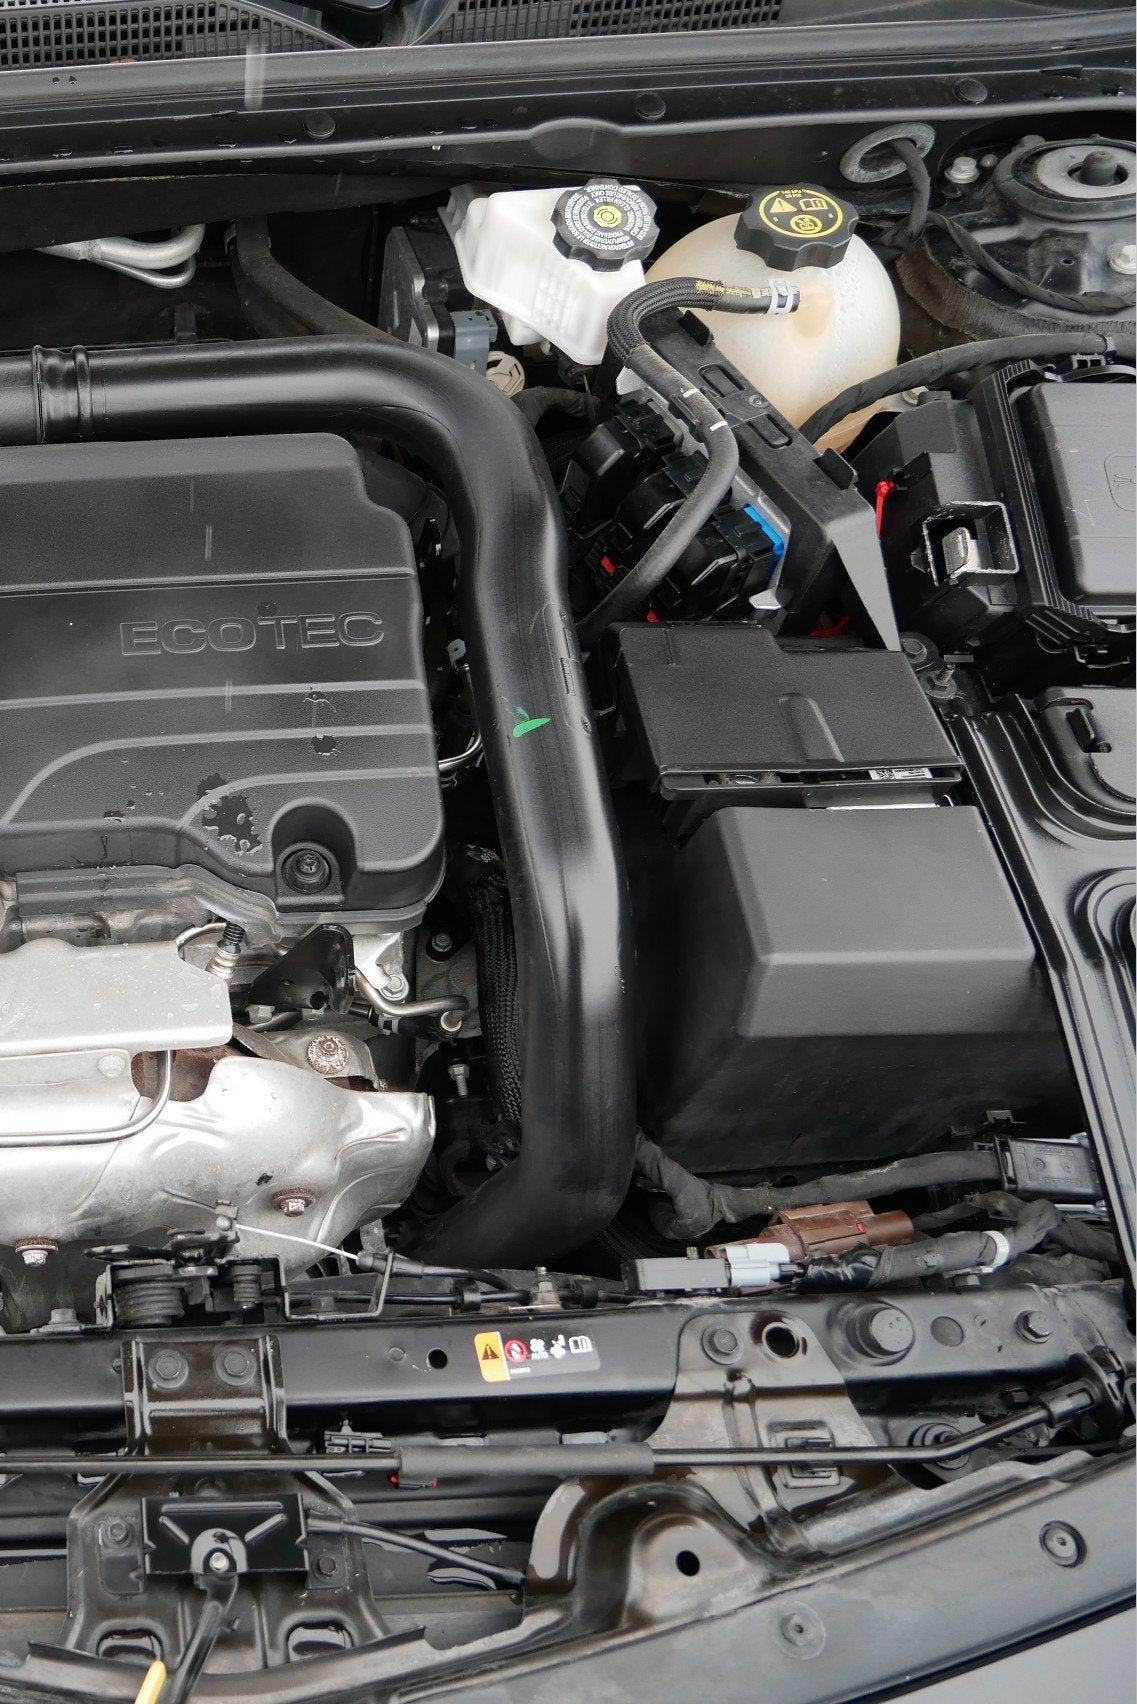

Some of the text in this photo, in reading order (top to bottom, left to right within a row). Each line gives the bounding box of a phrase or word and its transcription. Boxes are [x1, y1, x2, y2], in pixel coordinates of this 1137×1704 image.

[593, 196, 614, 204] FILLER
[120, 611, 384, 656] ECOTEC
[531, 1351, 548, 1360] AUTO
